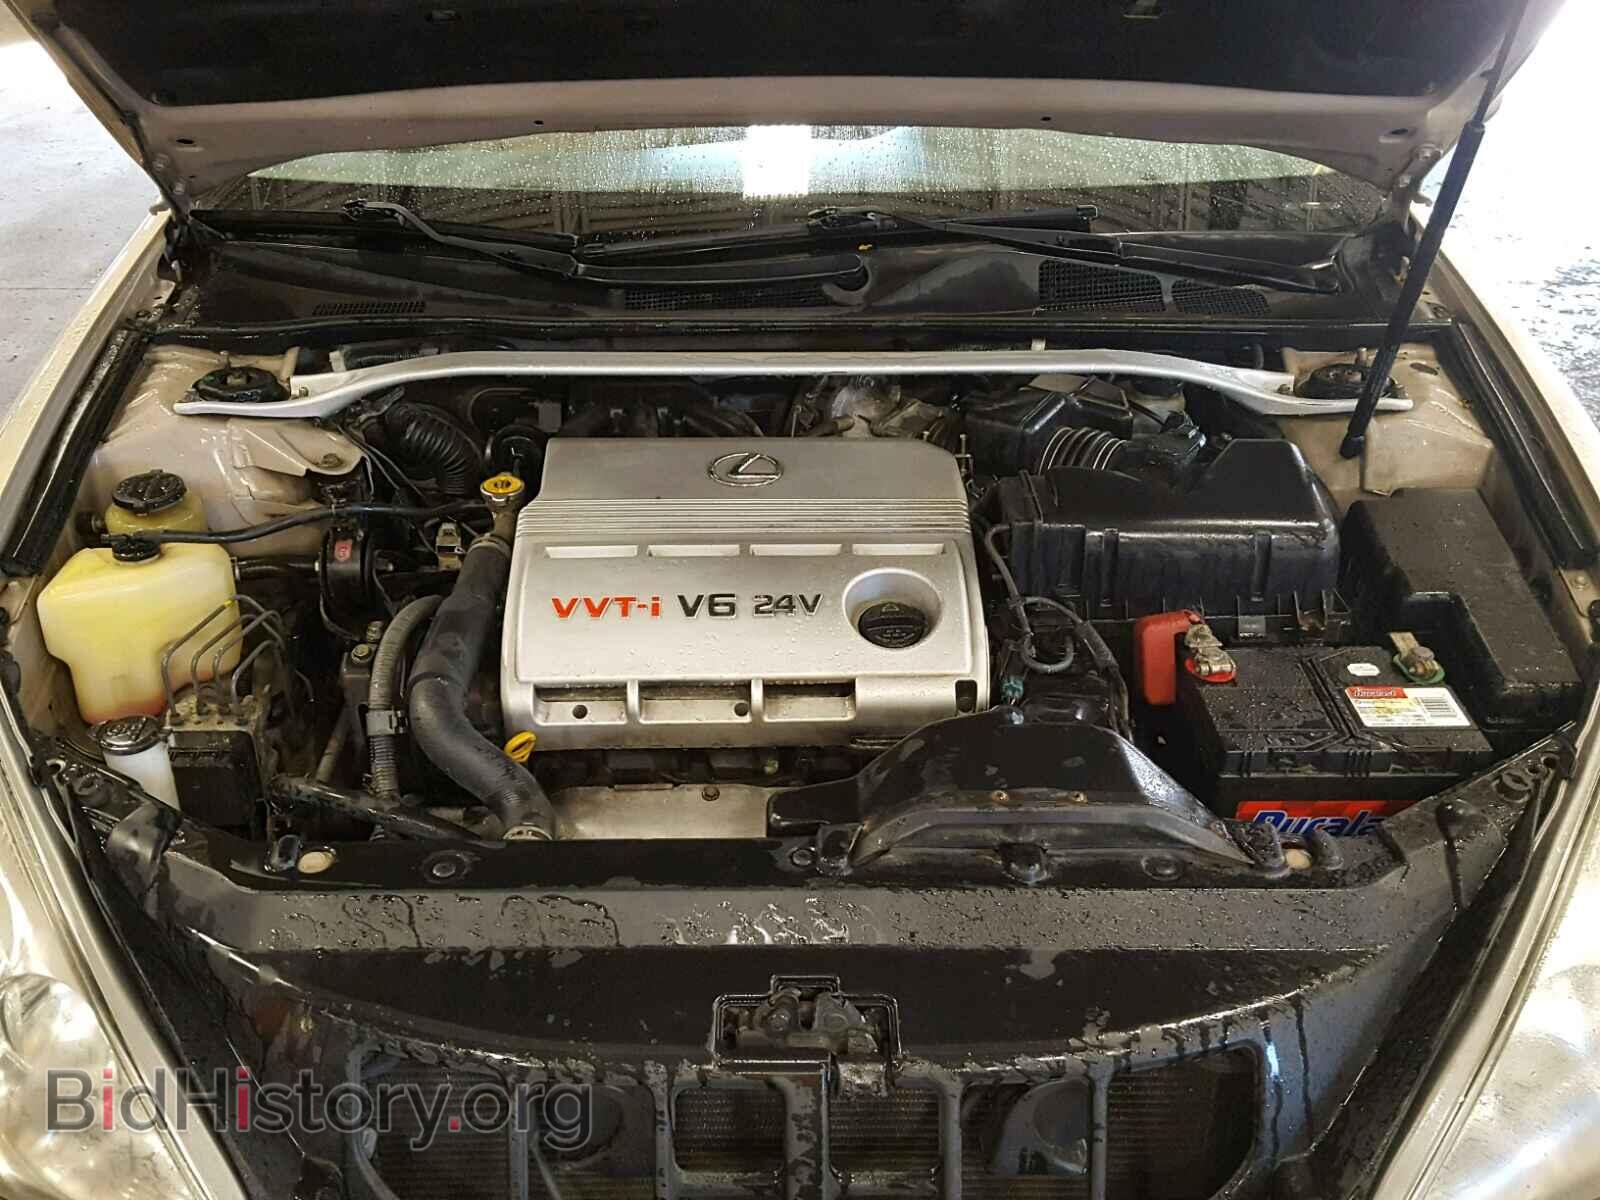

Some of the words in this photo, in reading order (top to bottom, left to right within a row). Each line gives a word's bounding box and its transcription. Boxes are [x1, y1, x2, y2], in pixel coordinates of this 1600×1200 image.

[551, 596, 662, 618] VVT-i
[677, 594, 737, 619] V6
[753, 594, 824, 617] 24V
